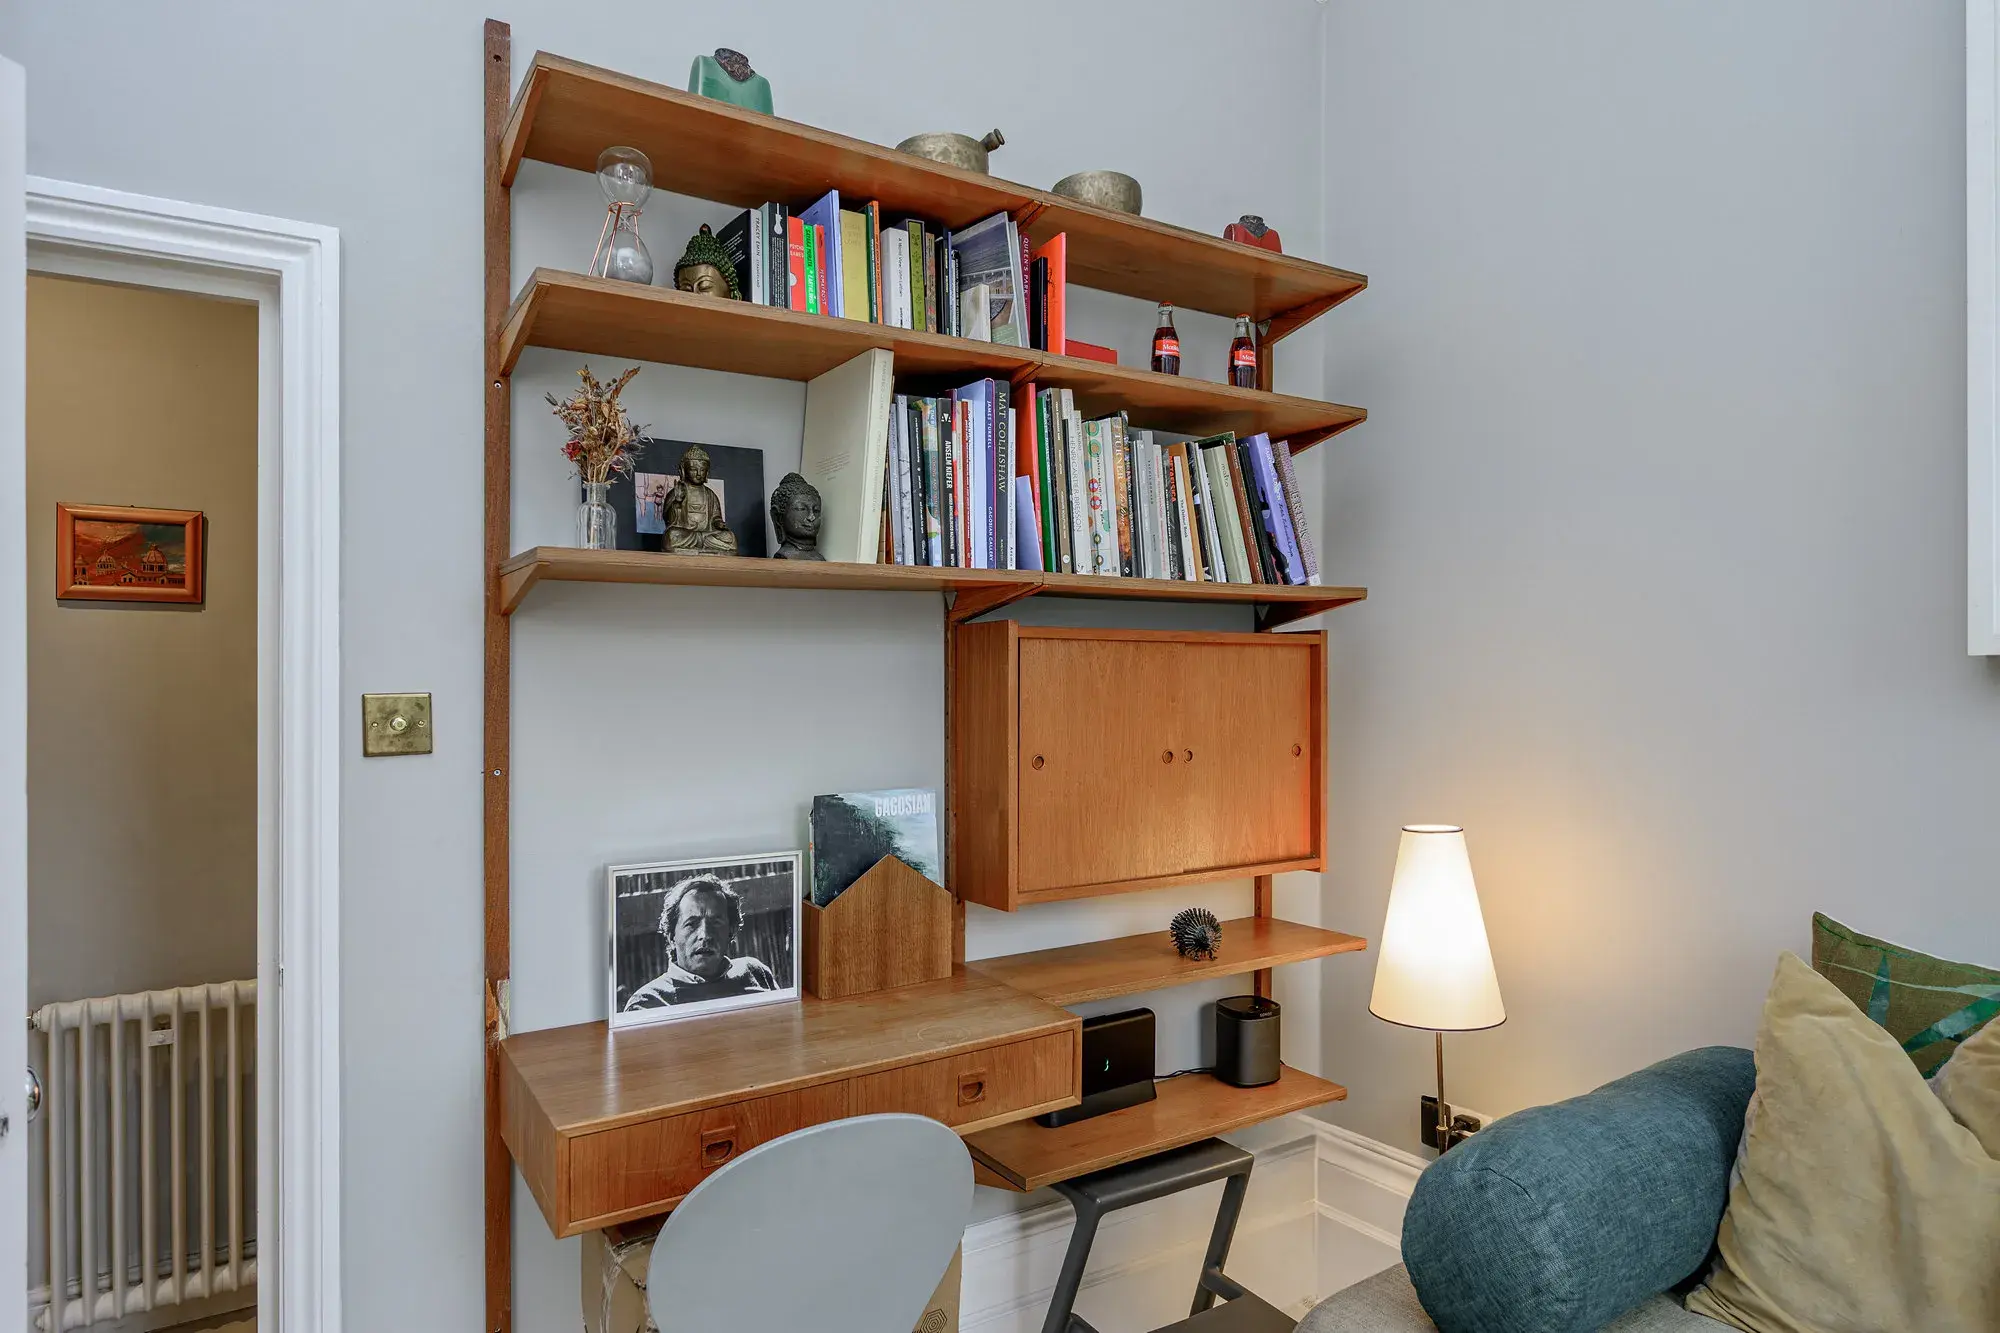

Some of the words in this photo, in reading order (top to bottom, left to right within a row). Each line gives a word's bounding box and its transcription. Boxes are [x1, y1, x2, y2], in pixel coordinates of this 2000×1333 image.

[998, 391, 1007, 419] MAT
[998, 421, 1007, 493] COLLISHAW
[1114, 432, 1124, 480] TURNER
[874, 793, 931, 818] GAGOSIAN
